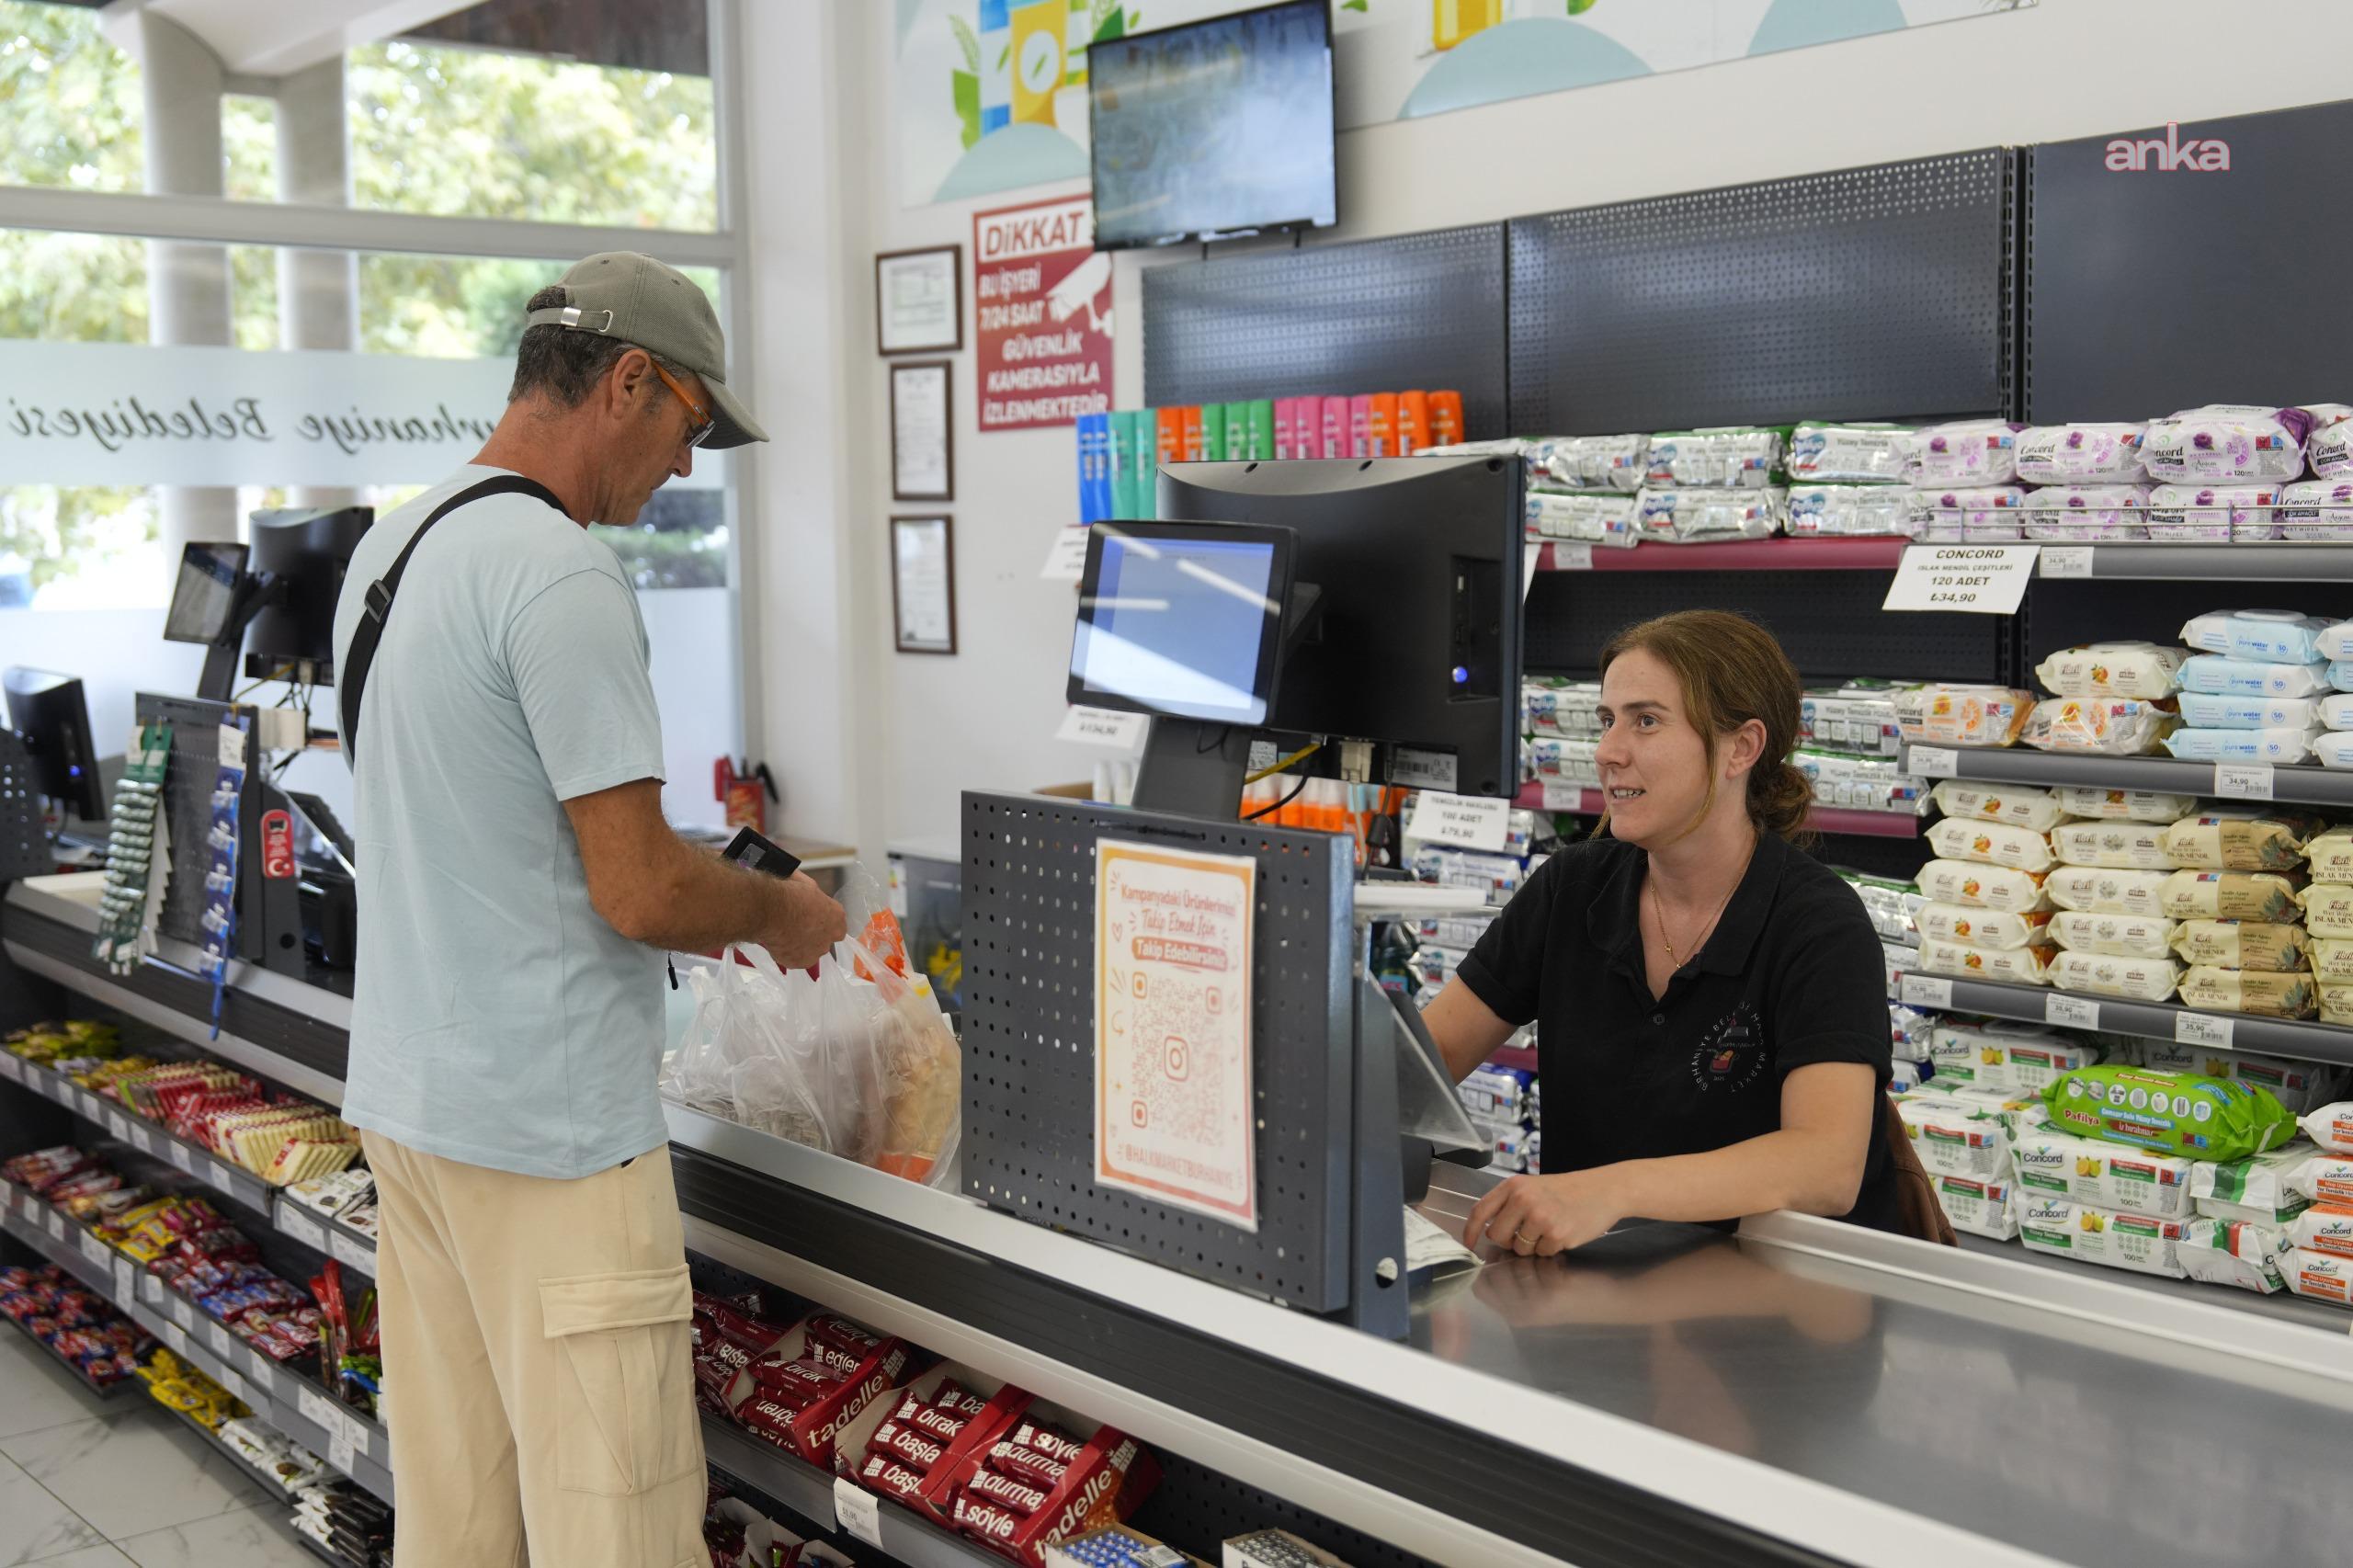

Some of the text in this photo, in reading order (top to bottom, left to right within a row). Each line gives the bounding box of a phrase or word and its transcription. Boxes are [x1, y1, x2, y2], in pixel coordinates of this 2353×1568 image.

[986, 211, 1085, 256] DİKKAT
[1002, 328, 1084, 361] GÜVENLİK
[986, 362, 1101, 393] KAMERASIYLA
[1936, 550, 2005, 560] CONCORD
[1932, 576, 1991, 585] 120 ADET
[1929, 593, 1976, 603] ₺34,90
[1136, 940, 1164, 959] Takip
[2185, 1023, 2204, 1032] 35,90
[1934, 1045, 1970, 1055] Concord
[2154, 1051, 2193, 1063] Concord
[2064, 1109, 2100, 1127] Pafilya
[2126, 1124, 2155, 1137] bırakmaz
[2023, 1153, 2063, 1165] Concord
[2120, 1199, 2133, 1207] 100
[2029, 1209, 2069, 1220] Concord
[2321, 1227, 2351, 1236] Concord
[2123, 1253, 2136, 1263] 100
[2308, 1264, 2338, 1274] Concord
[807, 1375, 883, 1449] tadelle
[915, 1408, 964, 1437] bırak
[893, 1430, 941, 1466] başla
[1009, 1446, 1068, 1478] durma
[983, 1475, 1045, 1509] durma
[966, 1505, 1015, 1538] söyle
[1033, 1469, 1111, 1561] tadelle
